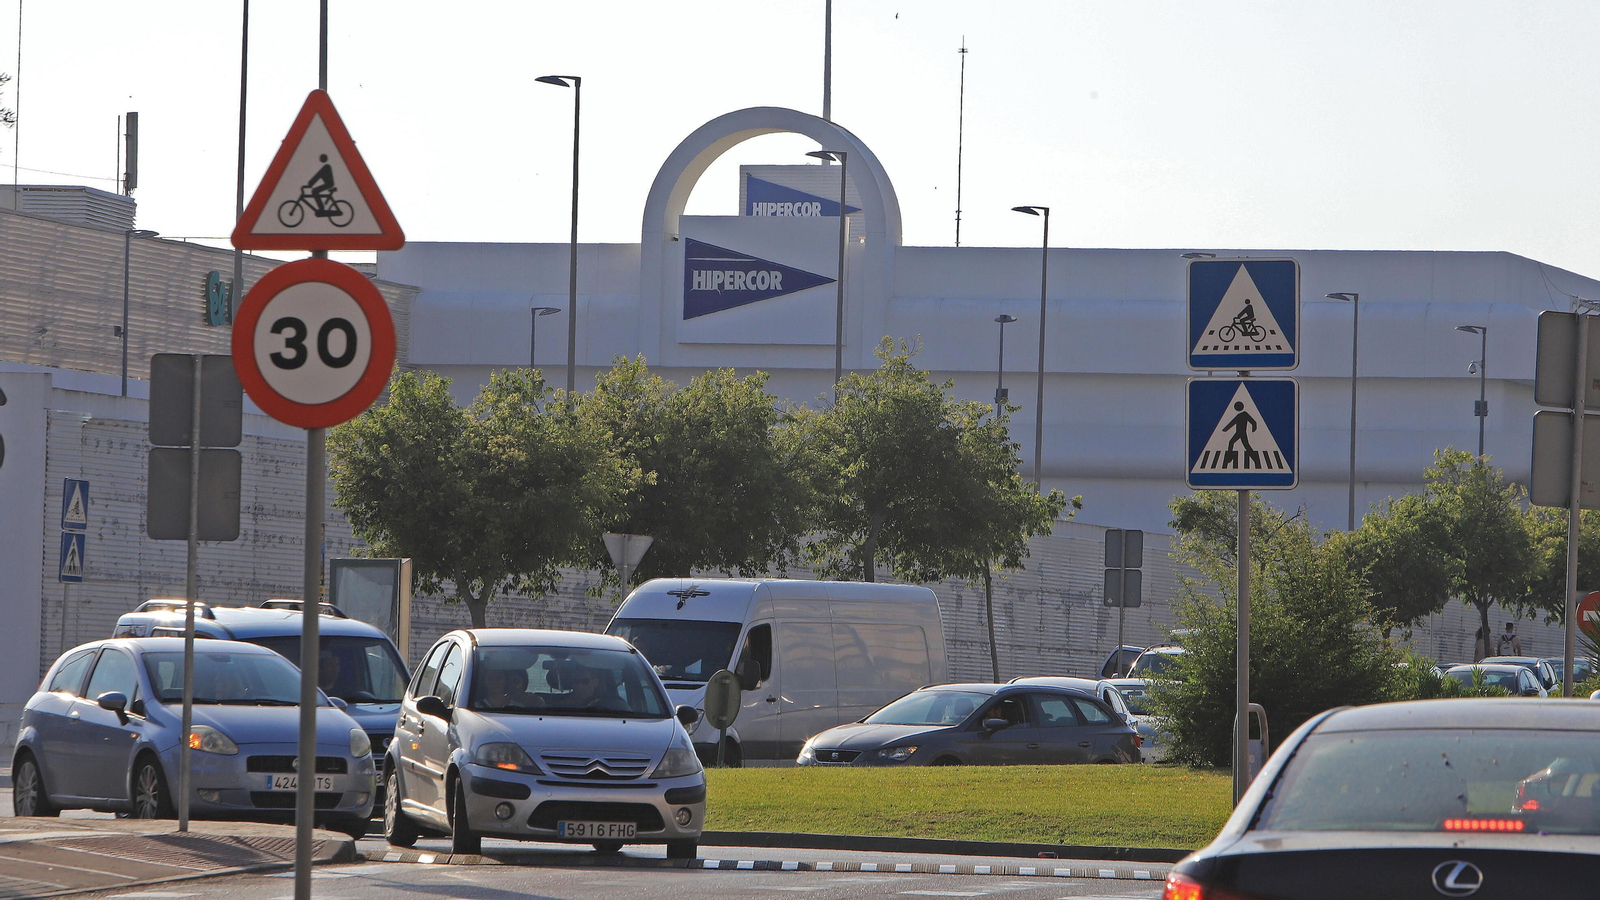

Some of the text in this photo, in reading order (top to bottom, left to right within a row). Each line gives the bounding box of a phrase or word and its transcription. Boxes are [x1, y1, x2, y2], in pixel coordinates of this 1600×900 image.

[752, 201, 822, 217] HIPERCOR
[692, 269, 783, 291] HIPERCOR
[269, 316, 358, 370] 30
[567, 823, 635, 837] 5916 FHG
